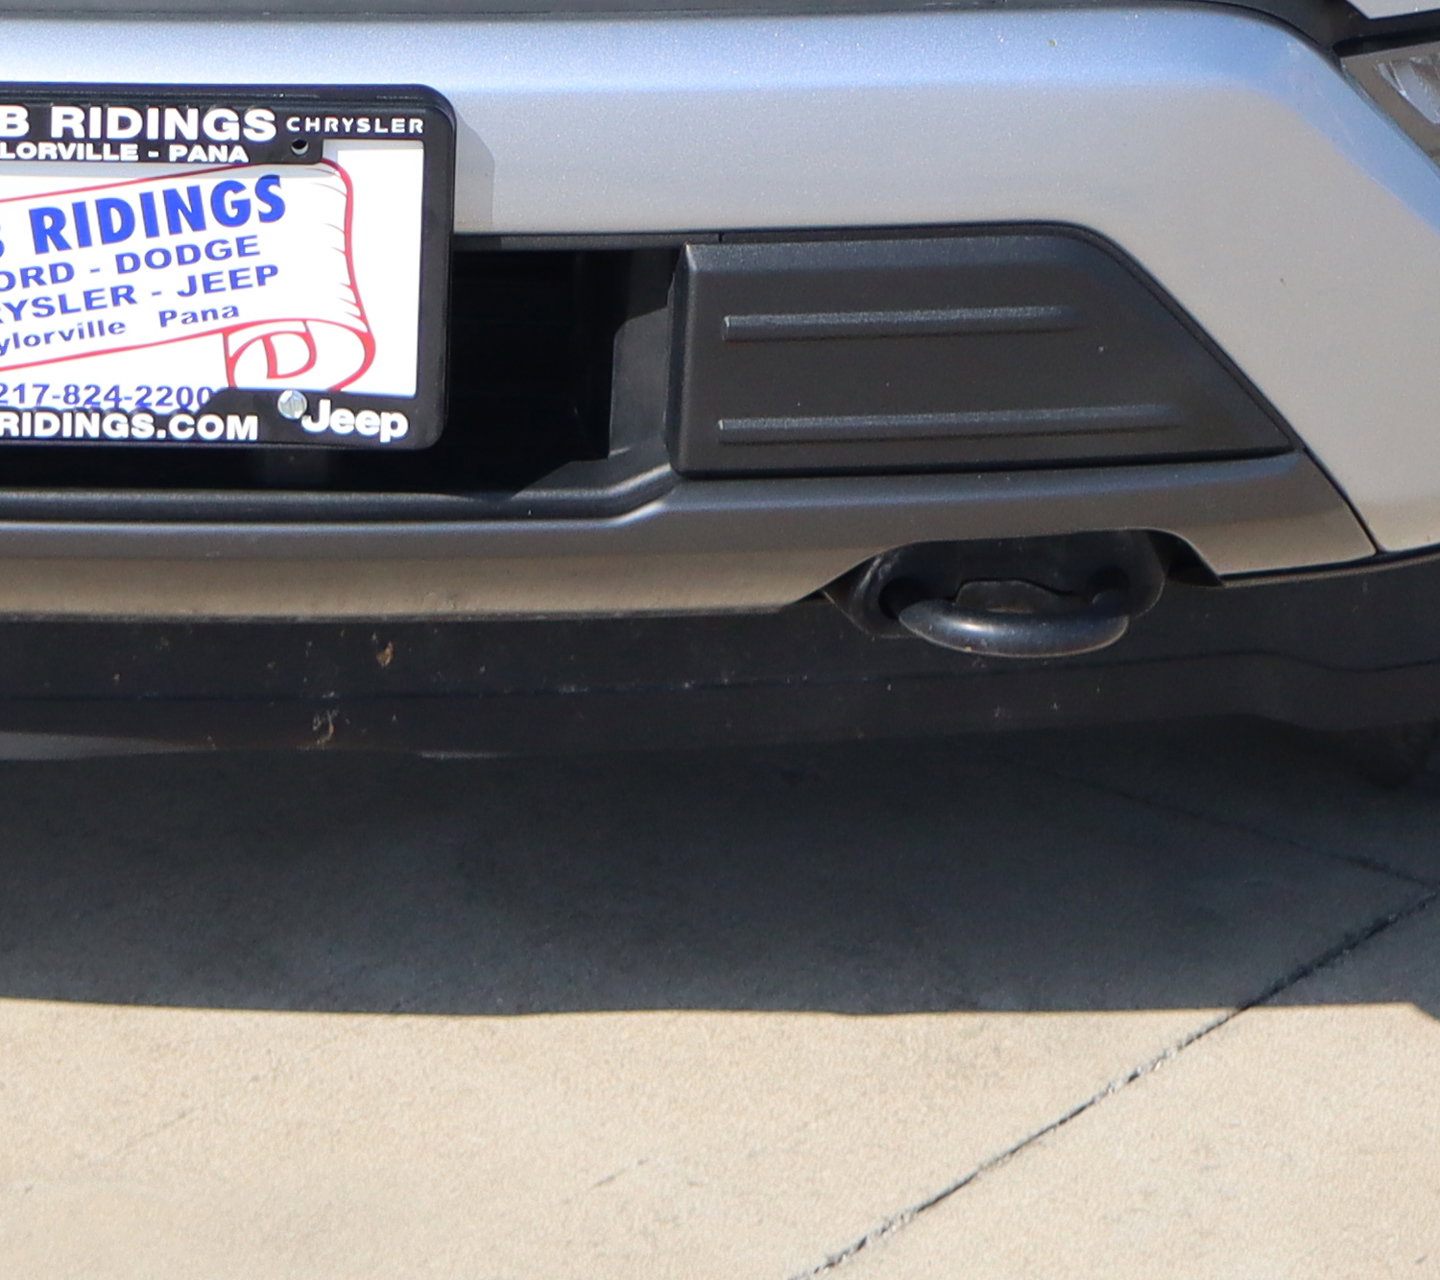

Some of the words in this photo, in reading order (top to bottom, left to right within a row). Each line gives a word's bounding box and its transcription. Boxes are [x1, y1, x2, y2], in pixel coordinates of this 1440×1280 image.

[50, 104, 278, 142] RIDINGS
[285, 116, 424, 134] CHRYSLER
[169, 143, 249, 163] PANA
[28, 173, 286, 255] RIDINGS
[115, 234, 261, 275] DODGE
[177, 264, 279, 299] JEEP
[158, 304, 240, 328] Pana
[301, 398, 409, 443] Jeep
